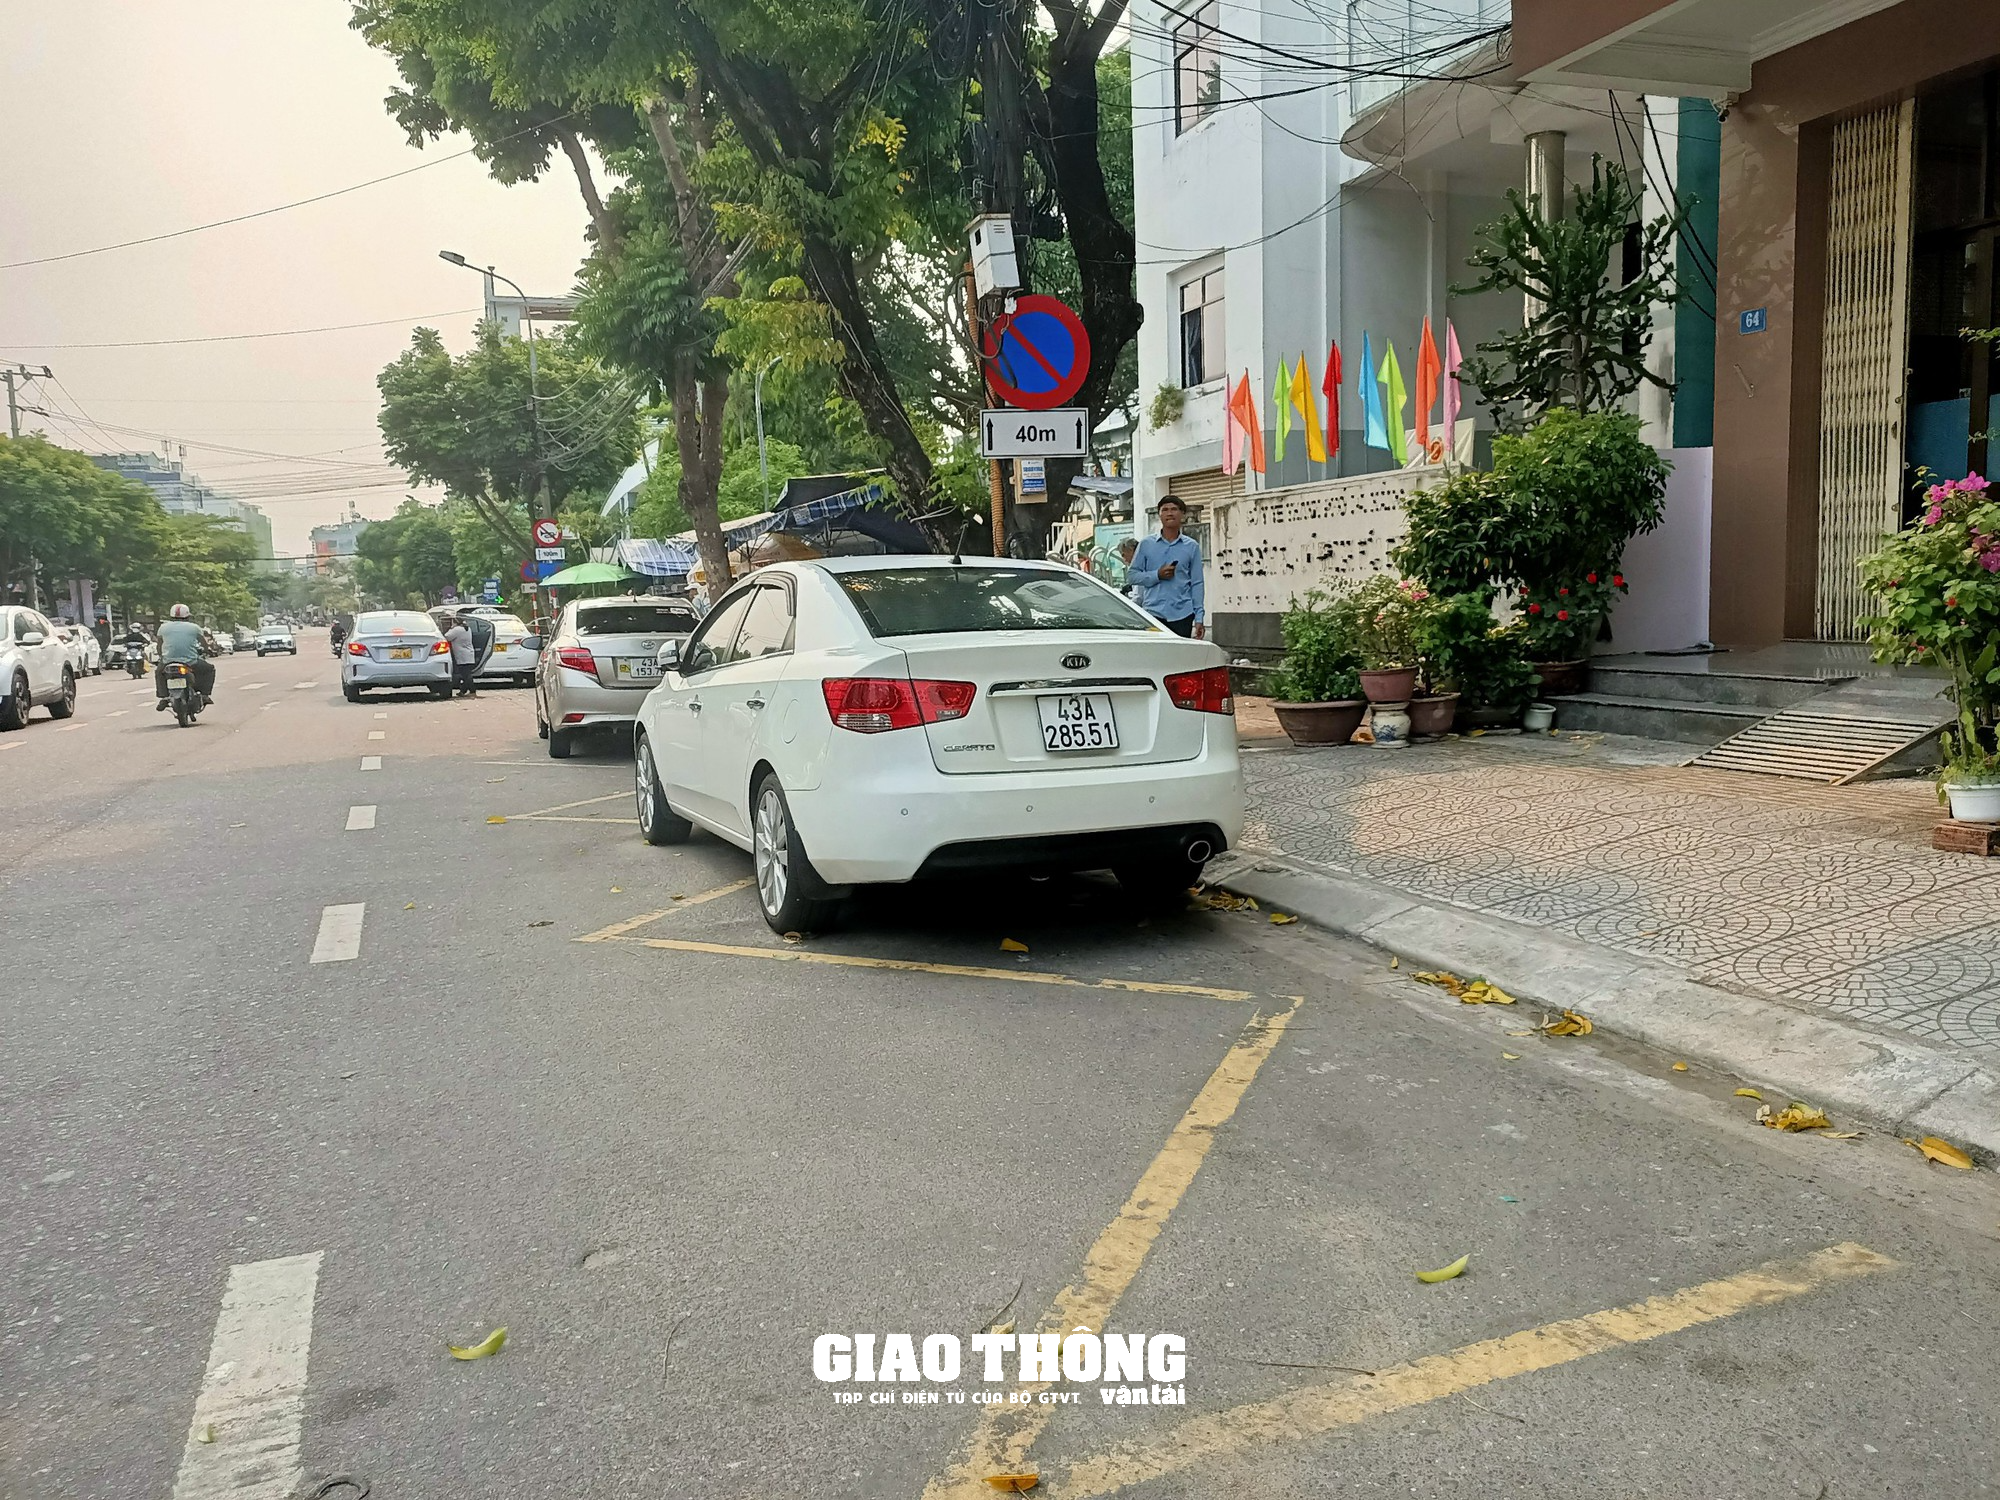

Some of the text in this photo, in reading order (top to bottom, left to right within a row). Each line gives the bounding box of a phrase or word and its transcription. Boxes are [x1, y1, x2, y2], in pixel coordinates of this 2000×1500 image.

[1746, 311, 1760, 328] 64
[1016, 425, 1056, 442] 40m
[641, 658, 658, 667] 43A
[1067, 657, 1086, 667] KIA
[1058, 697, 1096, 721] 43A
[1045, 722, 1113, 749] 285.51
